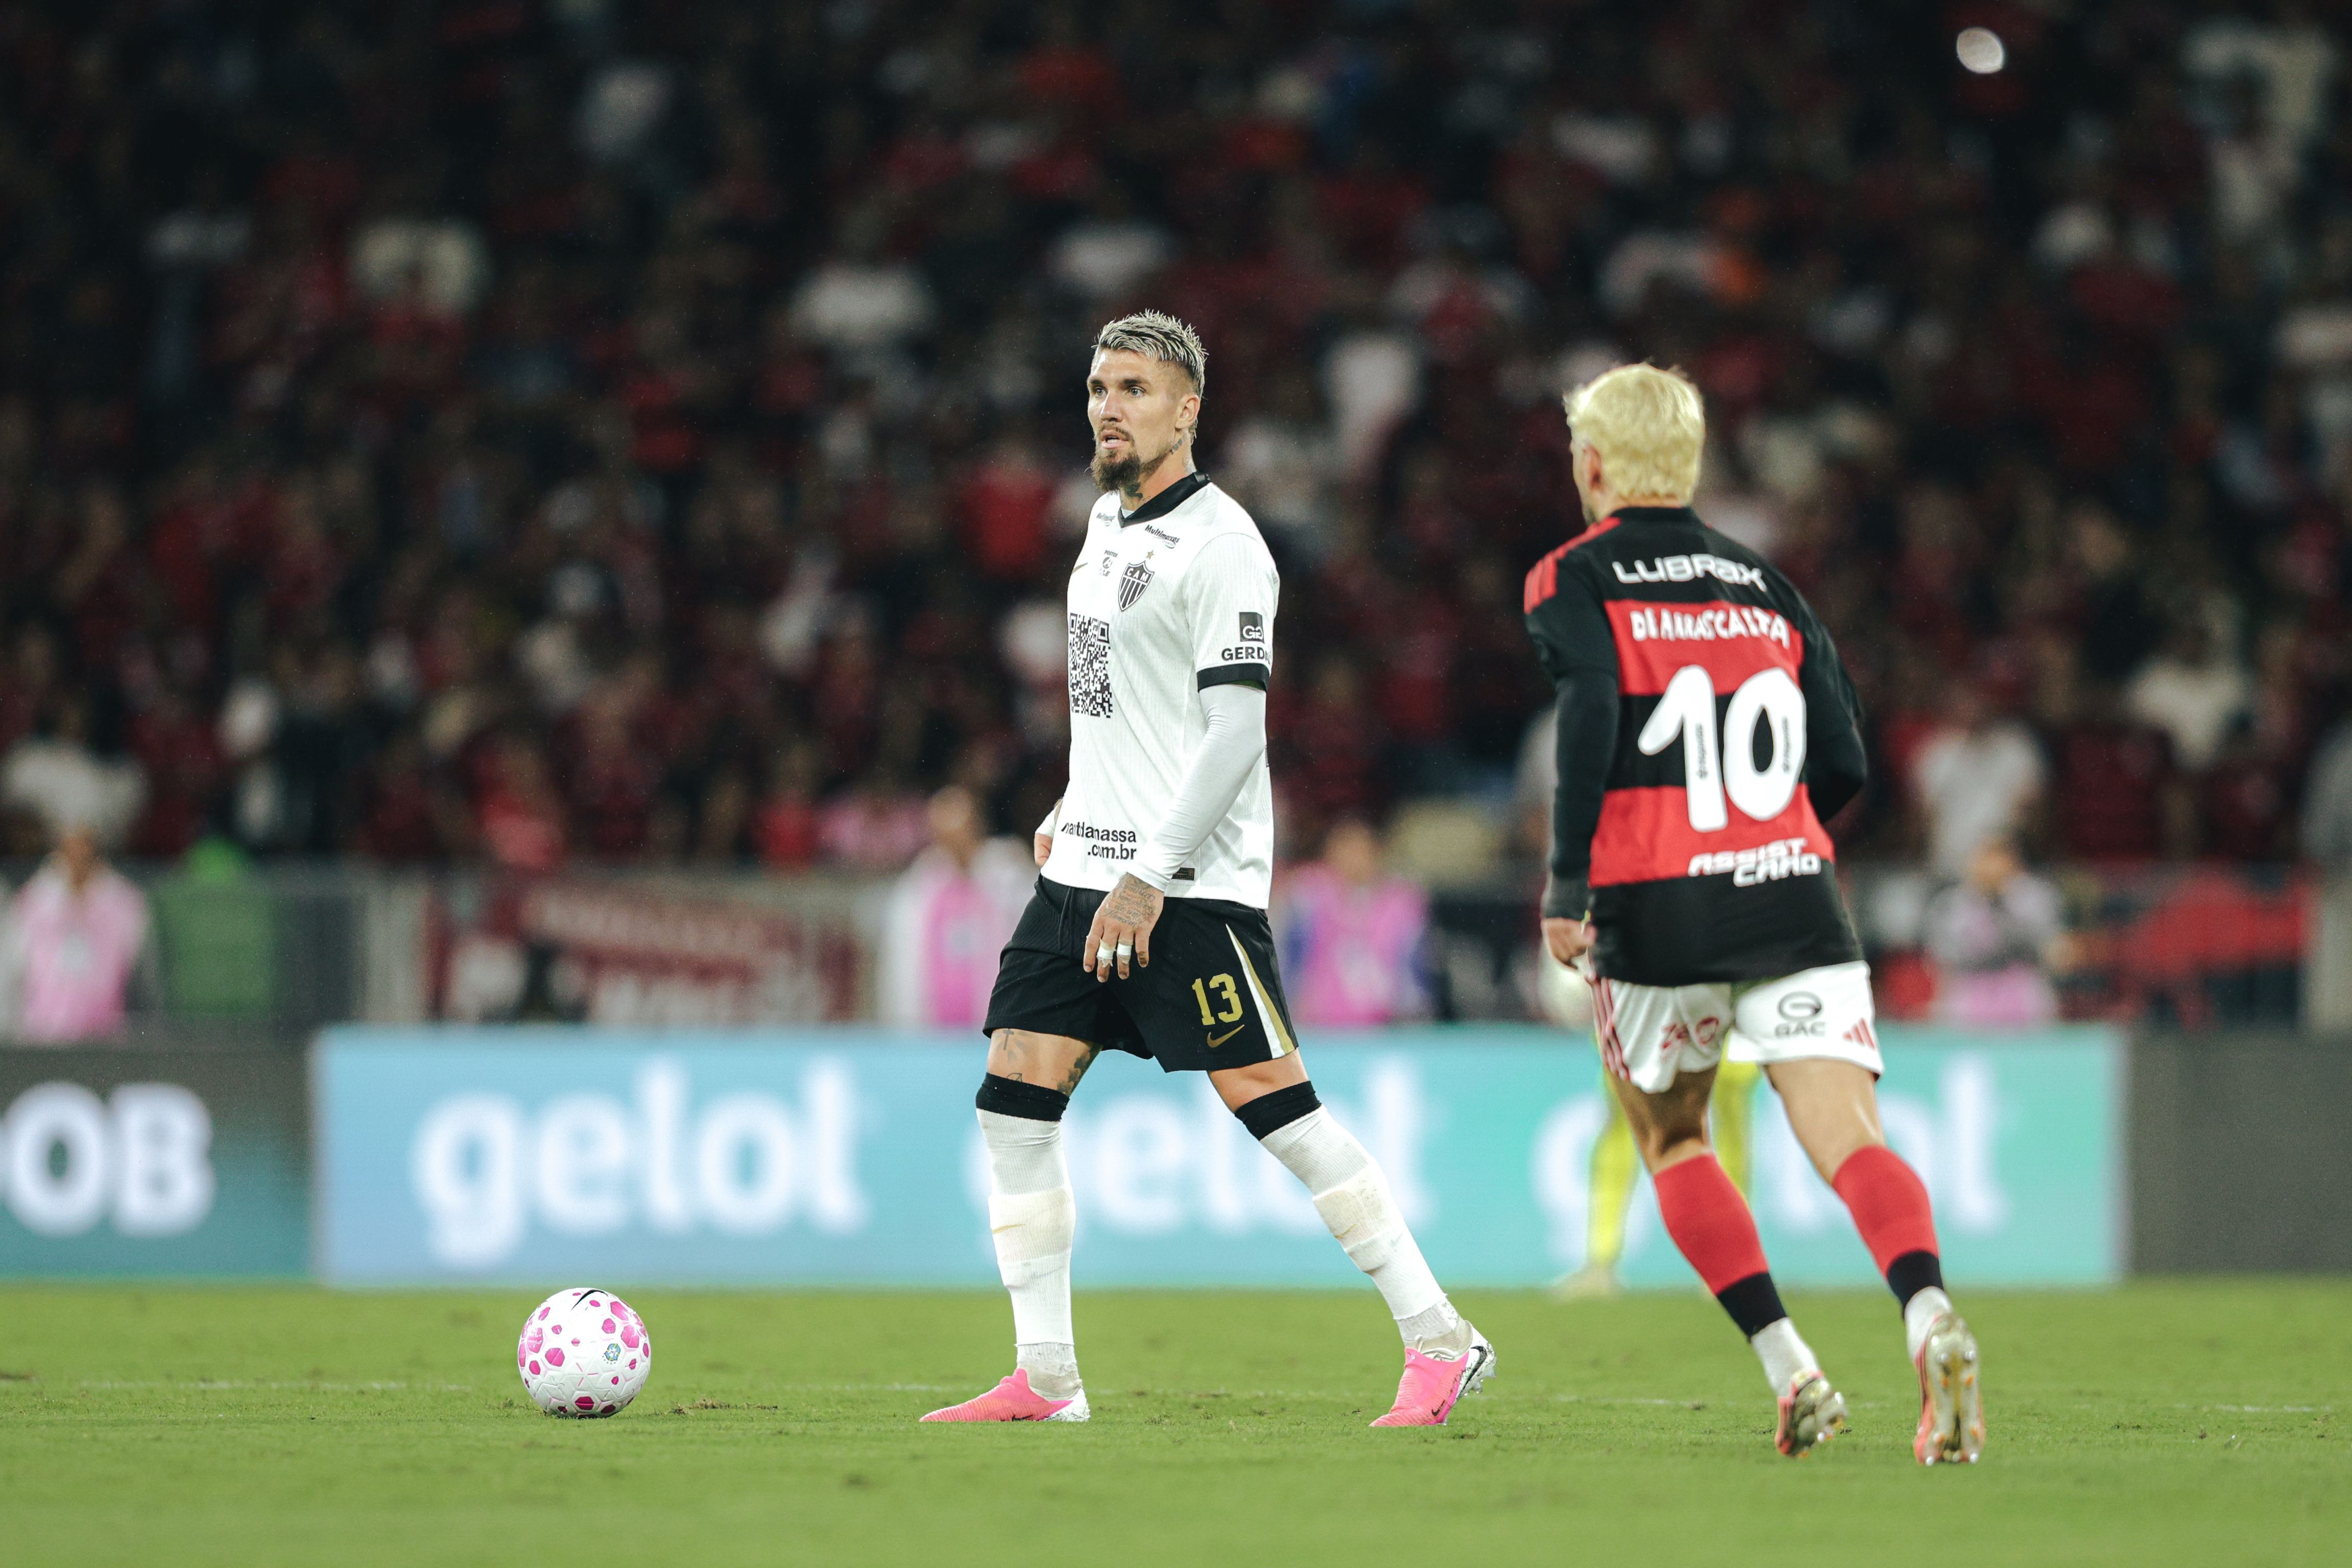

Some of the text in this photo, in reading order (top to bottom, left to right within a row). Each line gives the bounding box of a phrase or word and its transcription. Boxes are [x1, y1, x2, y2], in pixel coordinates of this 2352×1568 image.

[1126, 568, 1149, 582] CAM
[1221, 646, 1271, 666] GERD
[1638, 665, 1807, 832] 10
[1192, 973, 1243, 1026] 13
